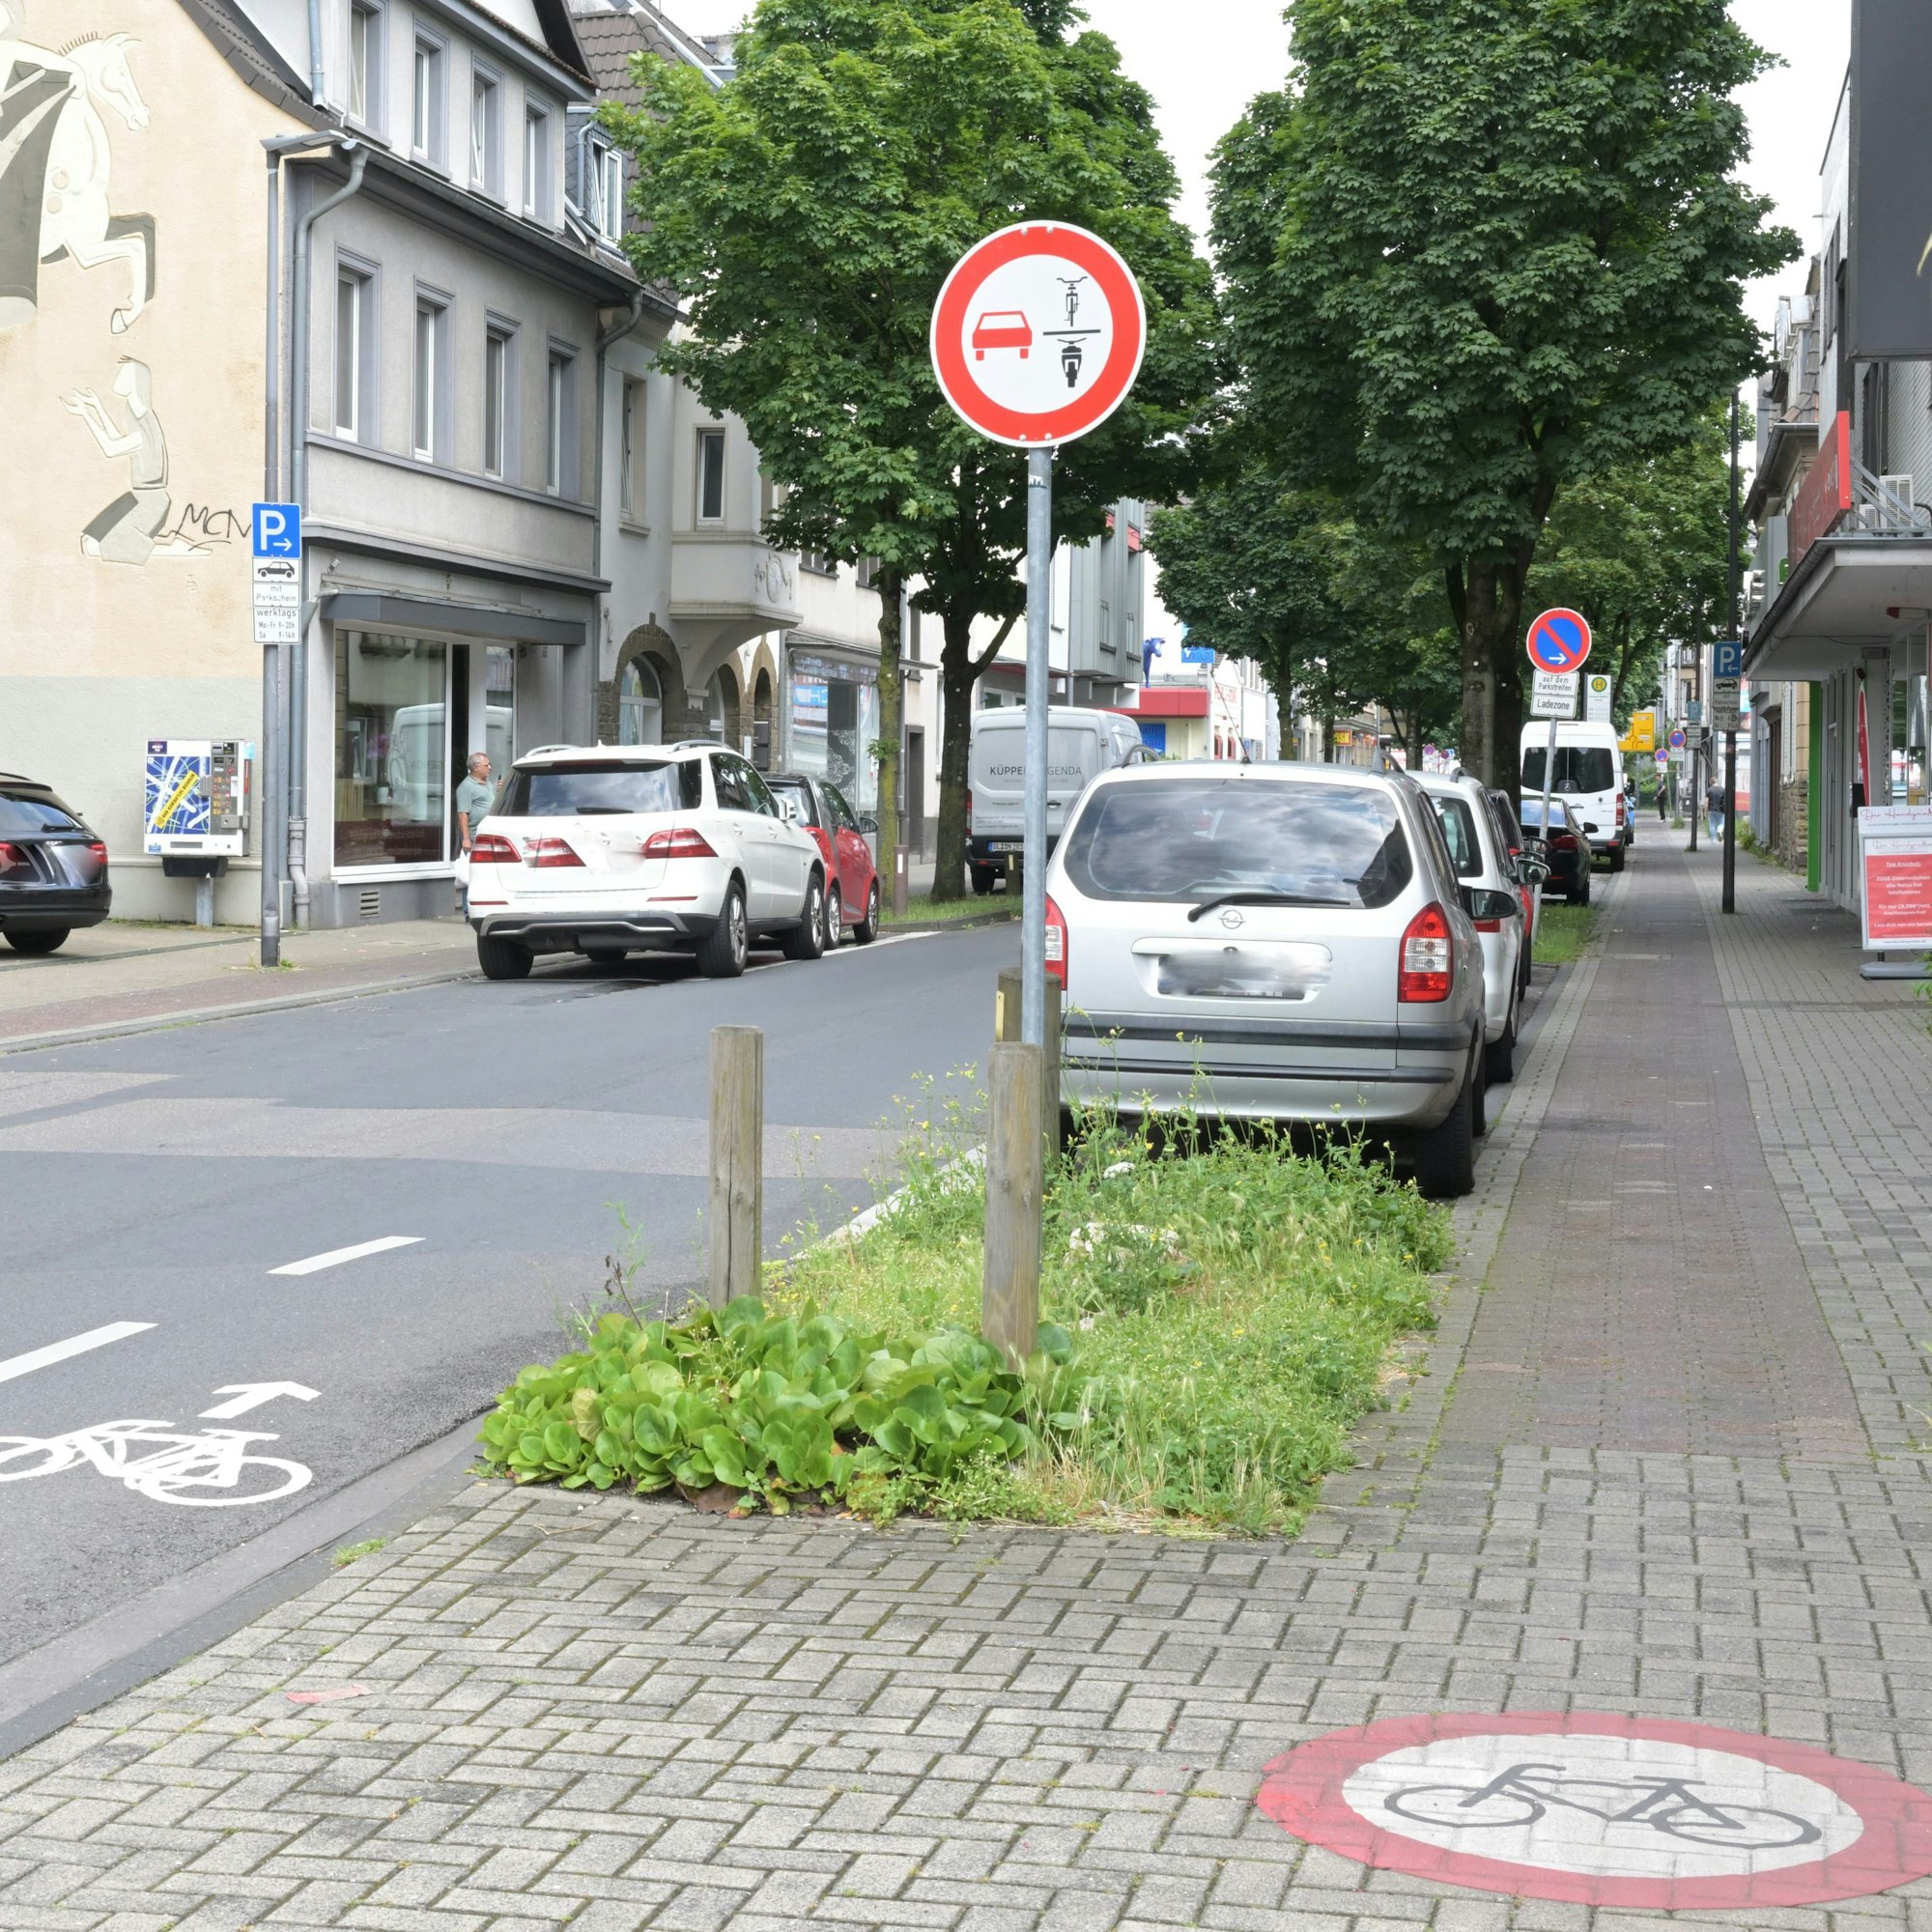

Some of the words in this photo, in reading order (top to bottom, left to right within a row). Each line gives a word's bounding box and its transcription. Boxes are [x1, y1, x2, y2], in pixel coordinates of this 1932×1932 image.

[260, 510, 286, 551] P
[257, 609, 297, 618] werktags
[1719, 646, 1735, 673] P
[1538, 682, 1572, 692] Parkstreifen
[1596, 680, 1604, 690] H
[1537, 698, 1570, 710] Ladezone
[990, 764, 1026, 775] KÜPPE
